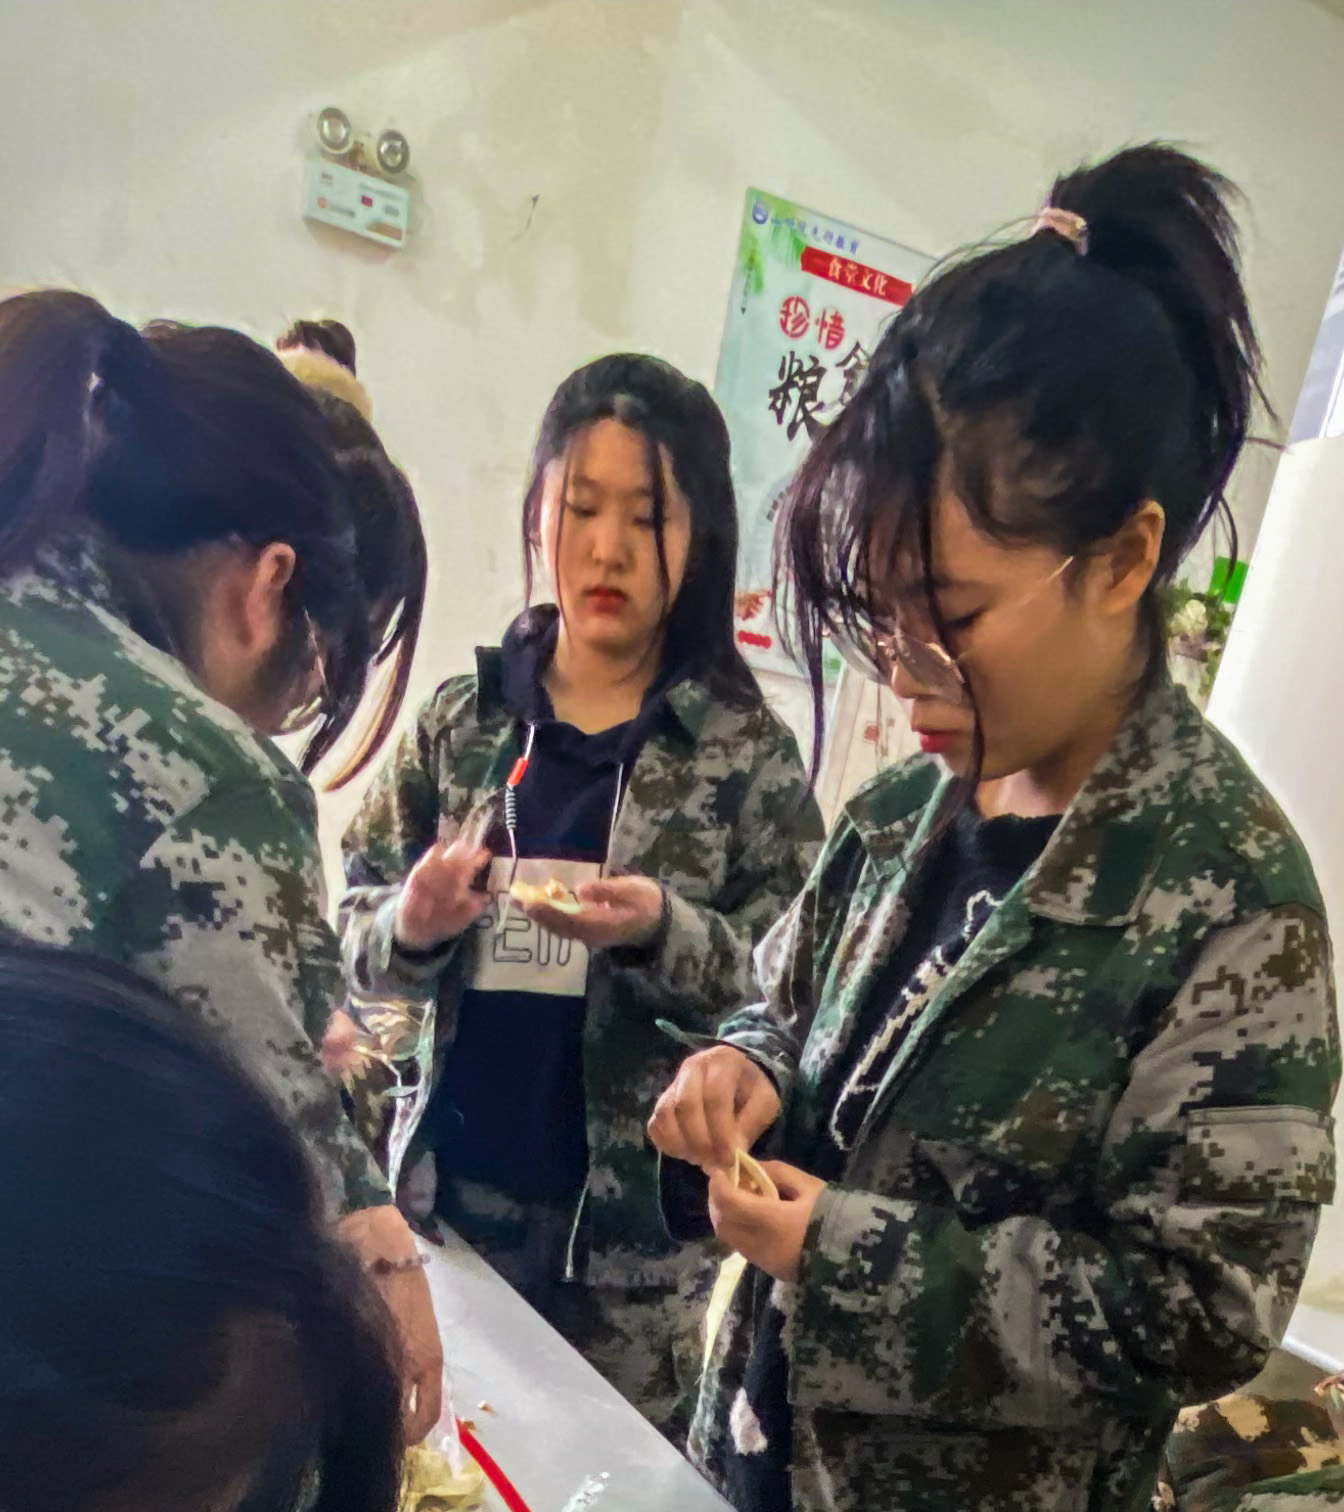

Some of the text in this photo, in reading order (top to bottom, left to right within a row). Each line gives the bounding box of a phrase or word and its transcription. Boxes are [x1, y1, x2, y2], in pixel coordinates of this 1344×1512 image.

[827, 256, 888, 296] 食堂文化
[779, 295, 845, 350] 珍惜
